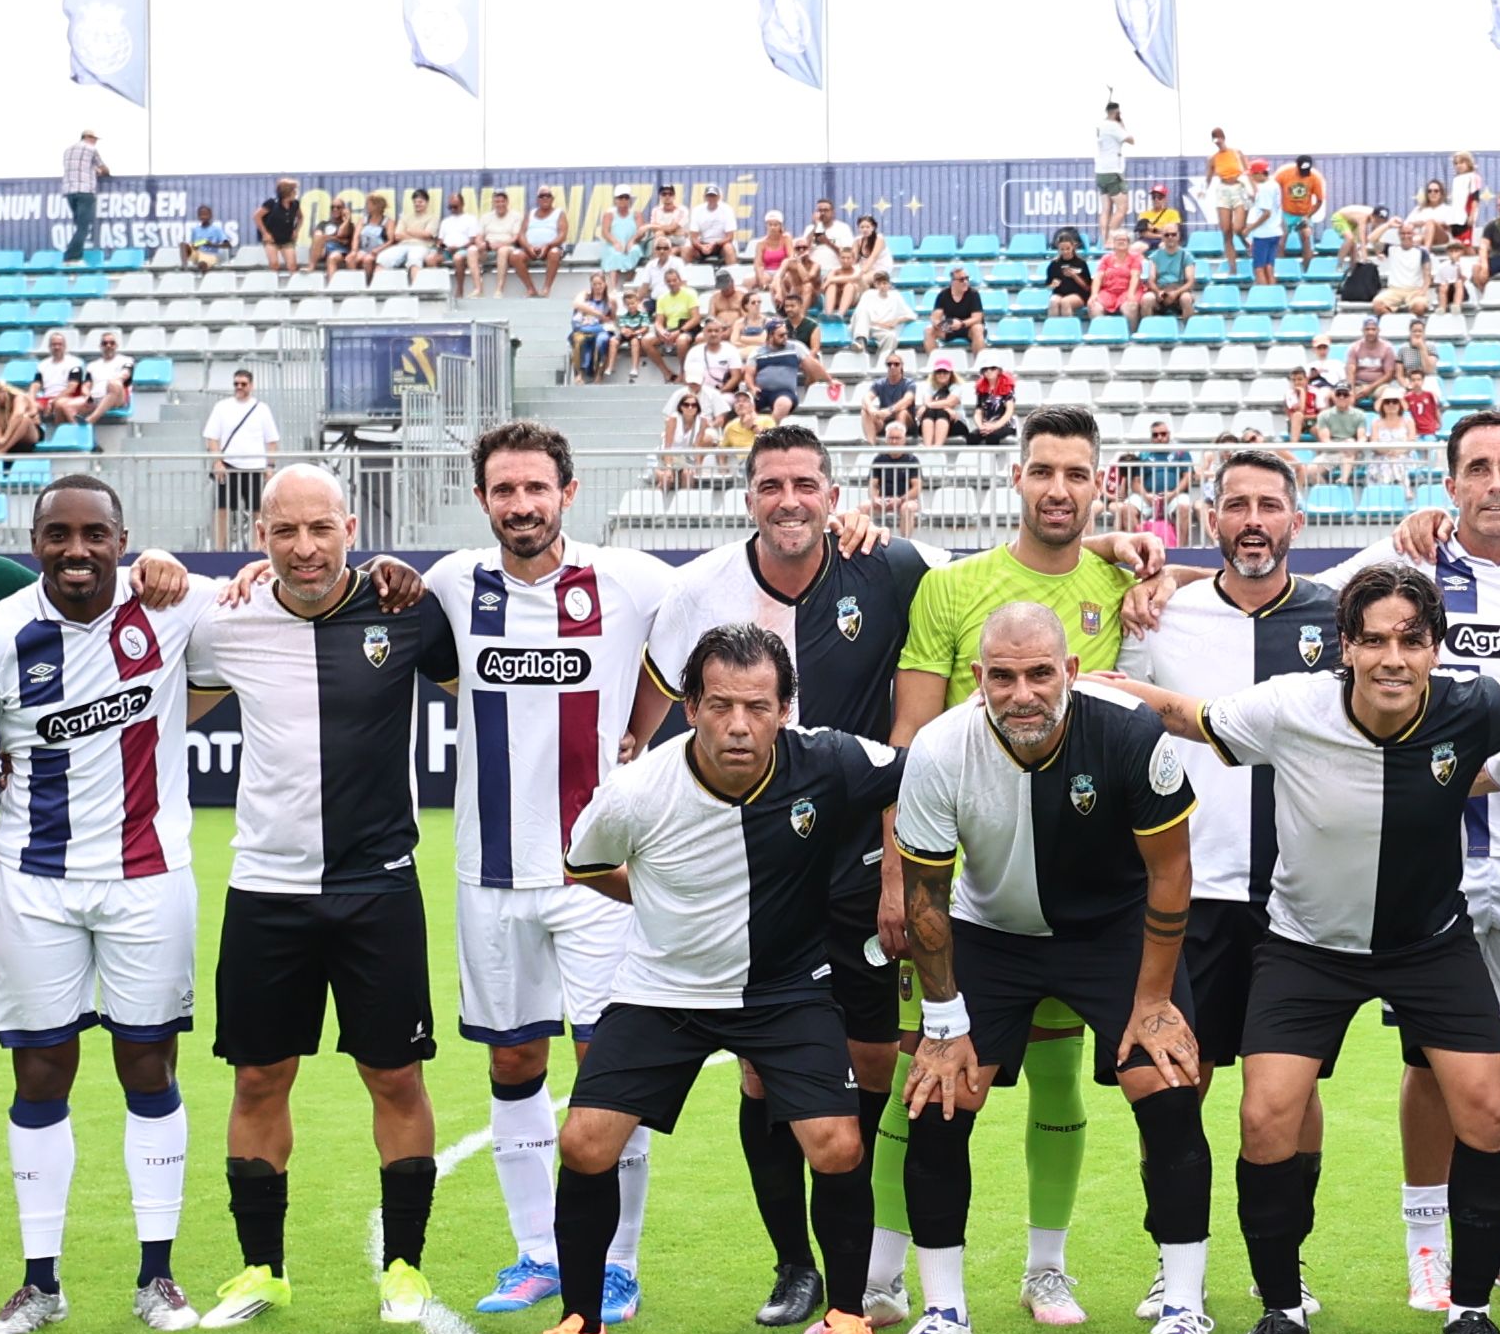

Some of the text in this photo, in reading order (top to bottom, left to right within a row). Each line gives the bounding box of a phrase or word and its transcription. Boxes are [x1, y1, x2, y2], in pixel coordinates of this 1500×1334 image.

[155, 191, 187, 217] EM
[1024, 189, 1067, 215] LIGA
[100, 223, 127, 249] AS
[485, 650, 581, 683] Agriloja
[48, 689, 147, 737] Agriloja
